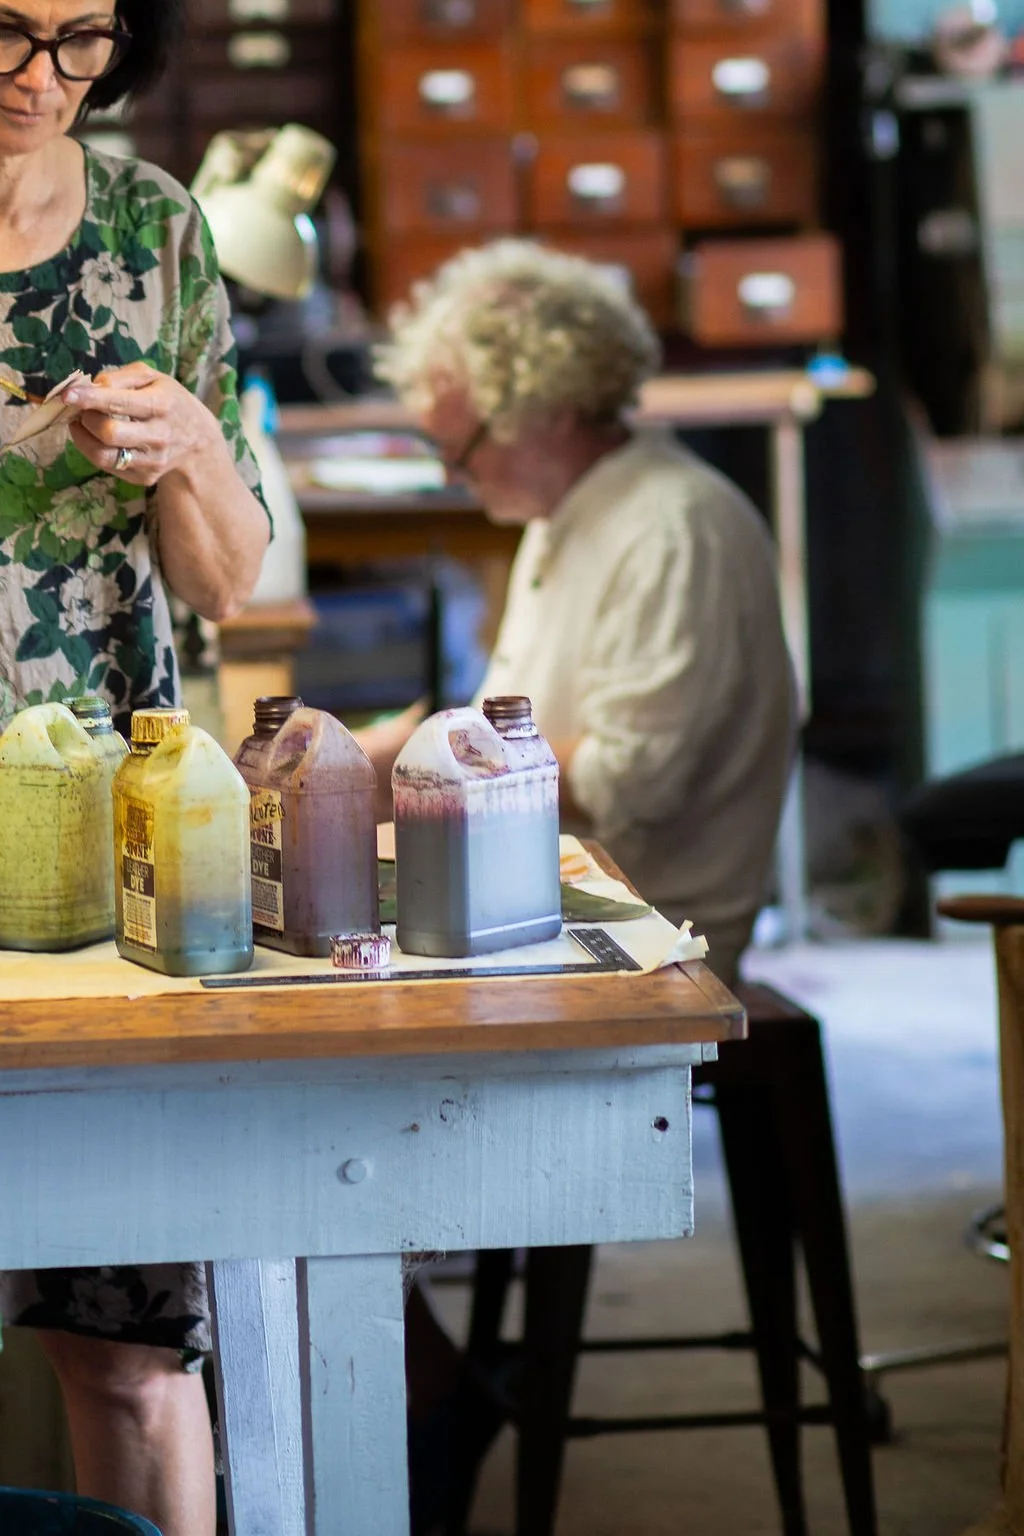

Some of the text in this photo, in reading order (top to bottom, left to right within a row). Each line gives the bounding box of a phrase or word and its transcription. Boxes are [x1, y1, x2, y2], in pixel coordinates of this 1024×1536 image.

[126, 859, 149, 878] LEATHER
[252, 860, 269, 877] DYE
[130, 874, 145, 893] DYE
